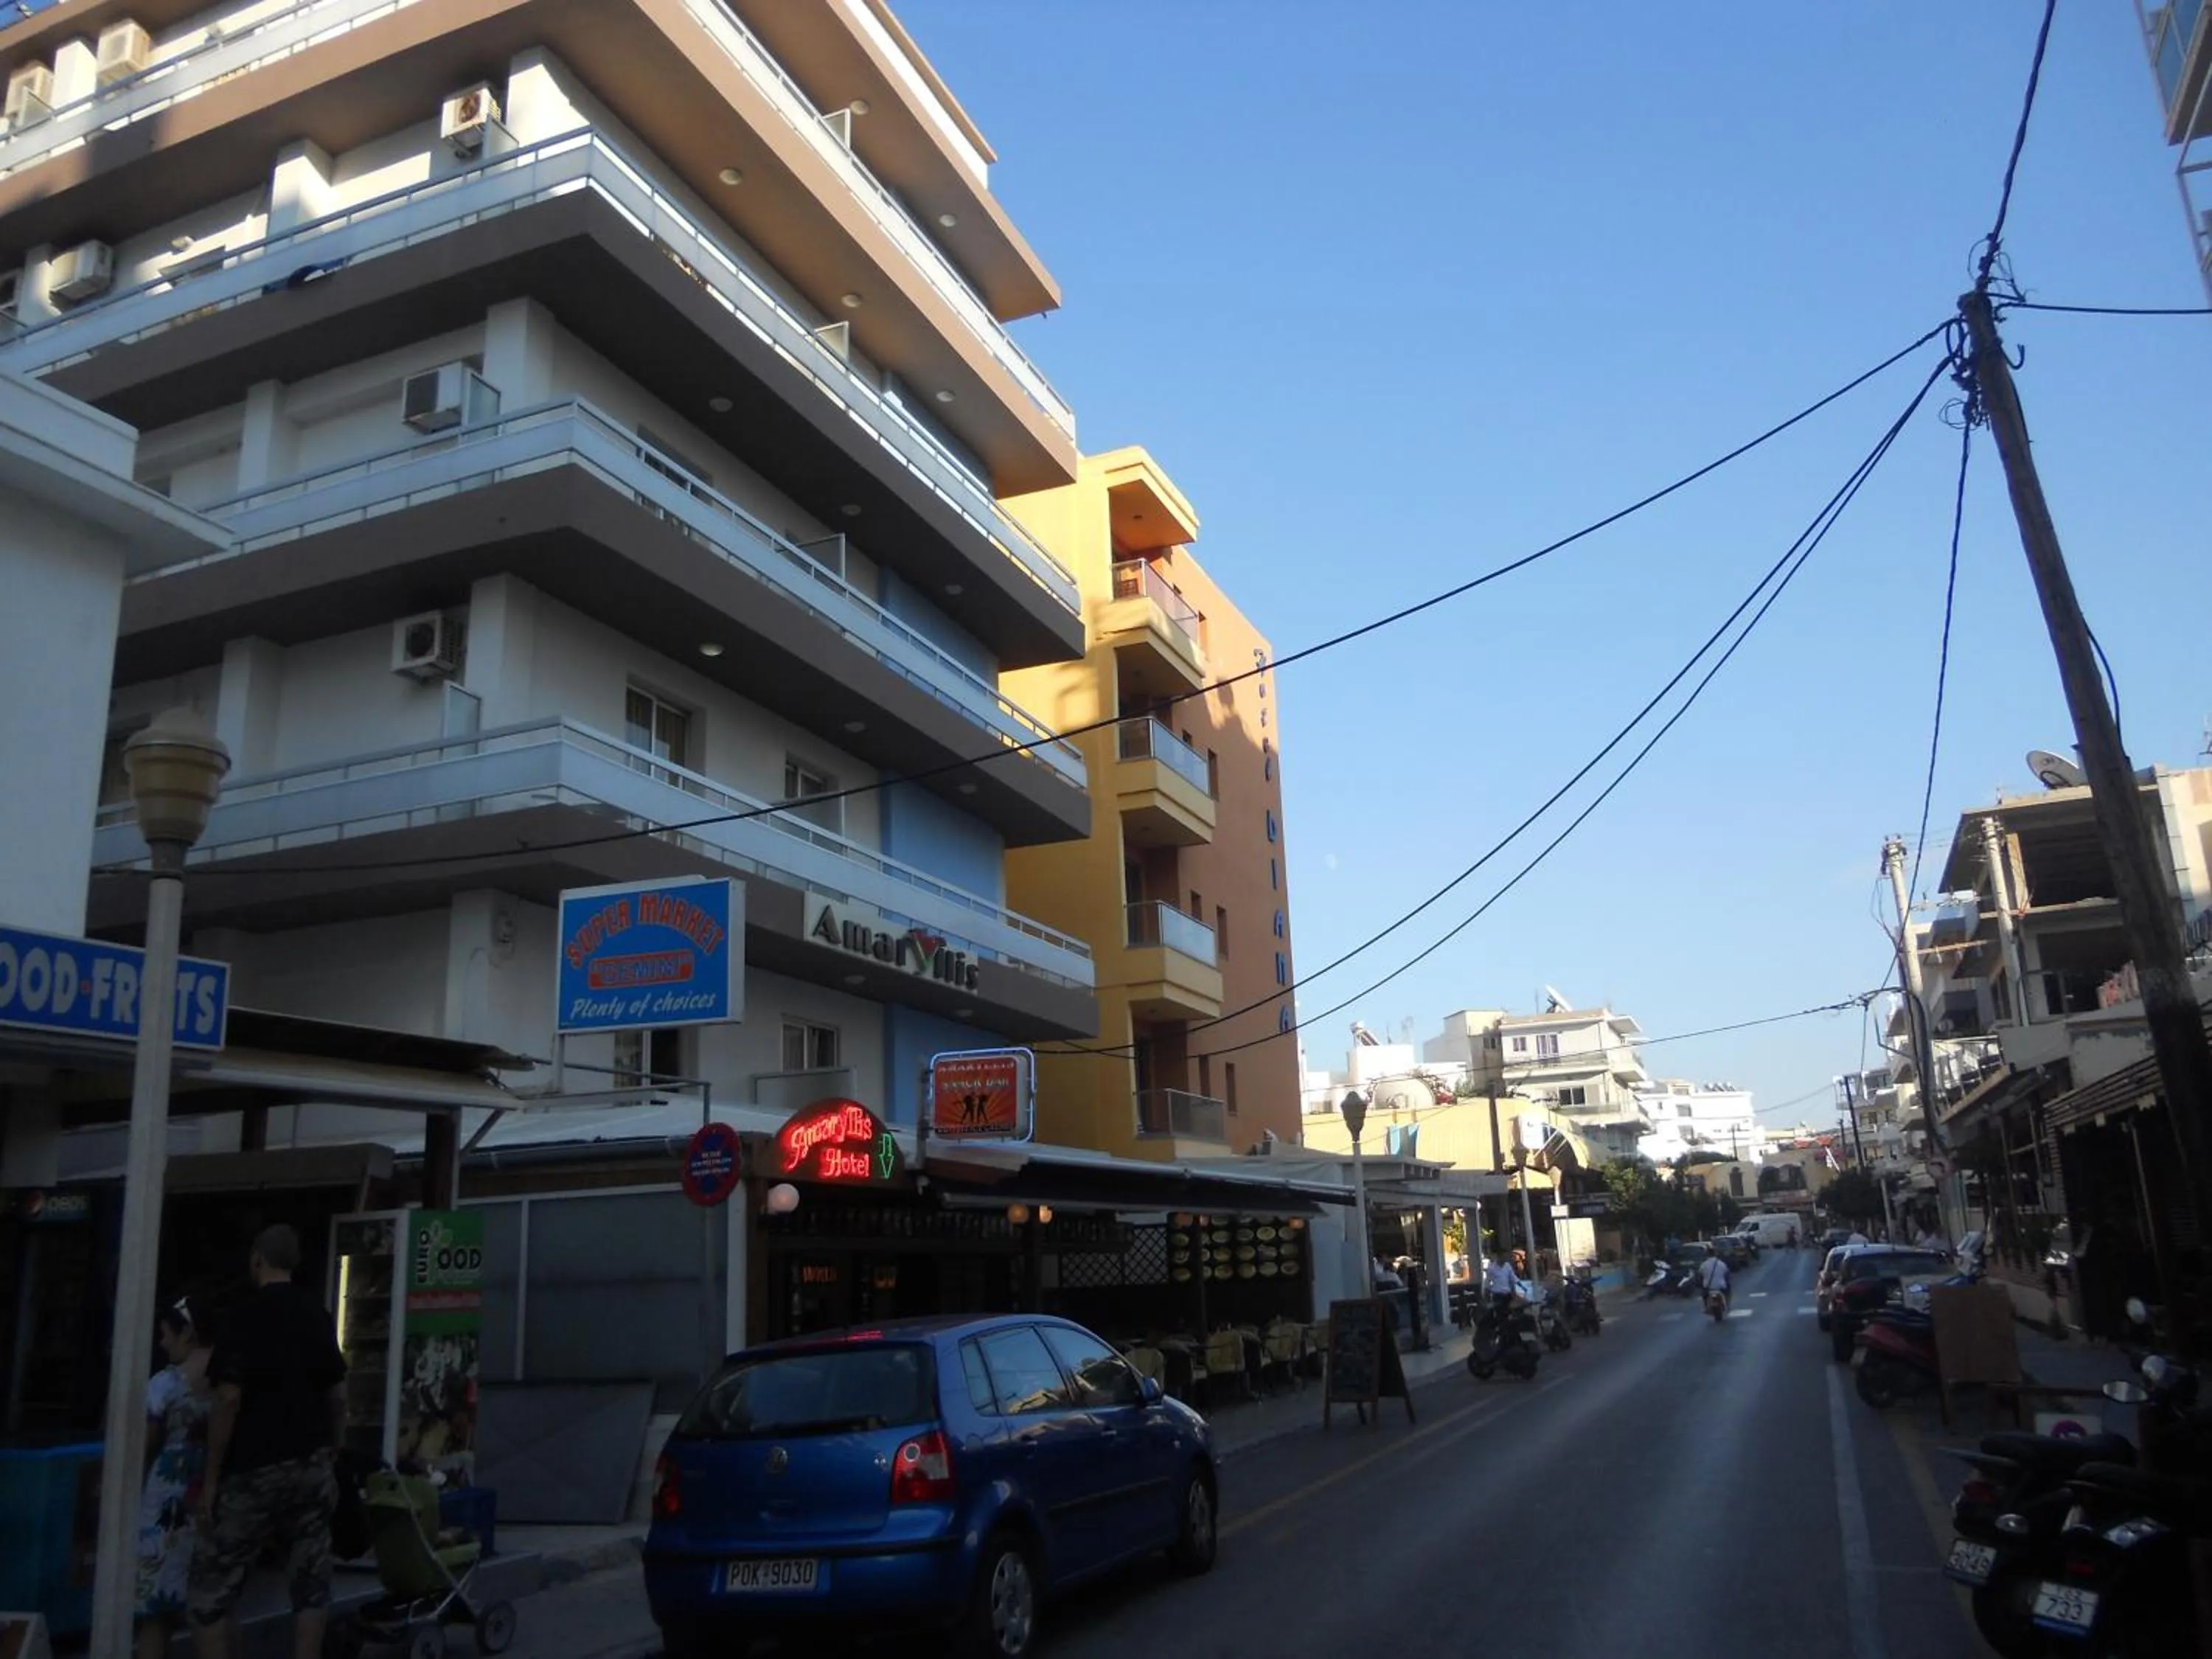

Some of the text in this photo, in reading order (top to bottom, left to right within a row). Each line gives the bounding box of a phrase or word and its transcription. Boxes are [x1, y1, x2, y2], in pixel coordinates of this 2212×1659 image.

[566, 893, 725, 969] SUPER MARKET
[90, 958, 216, 1034] FRTS
[570, 990, 717, 1020] Plenty of choices
[822, 1148, 870, 1178] Hotel
